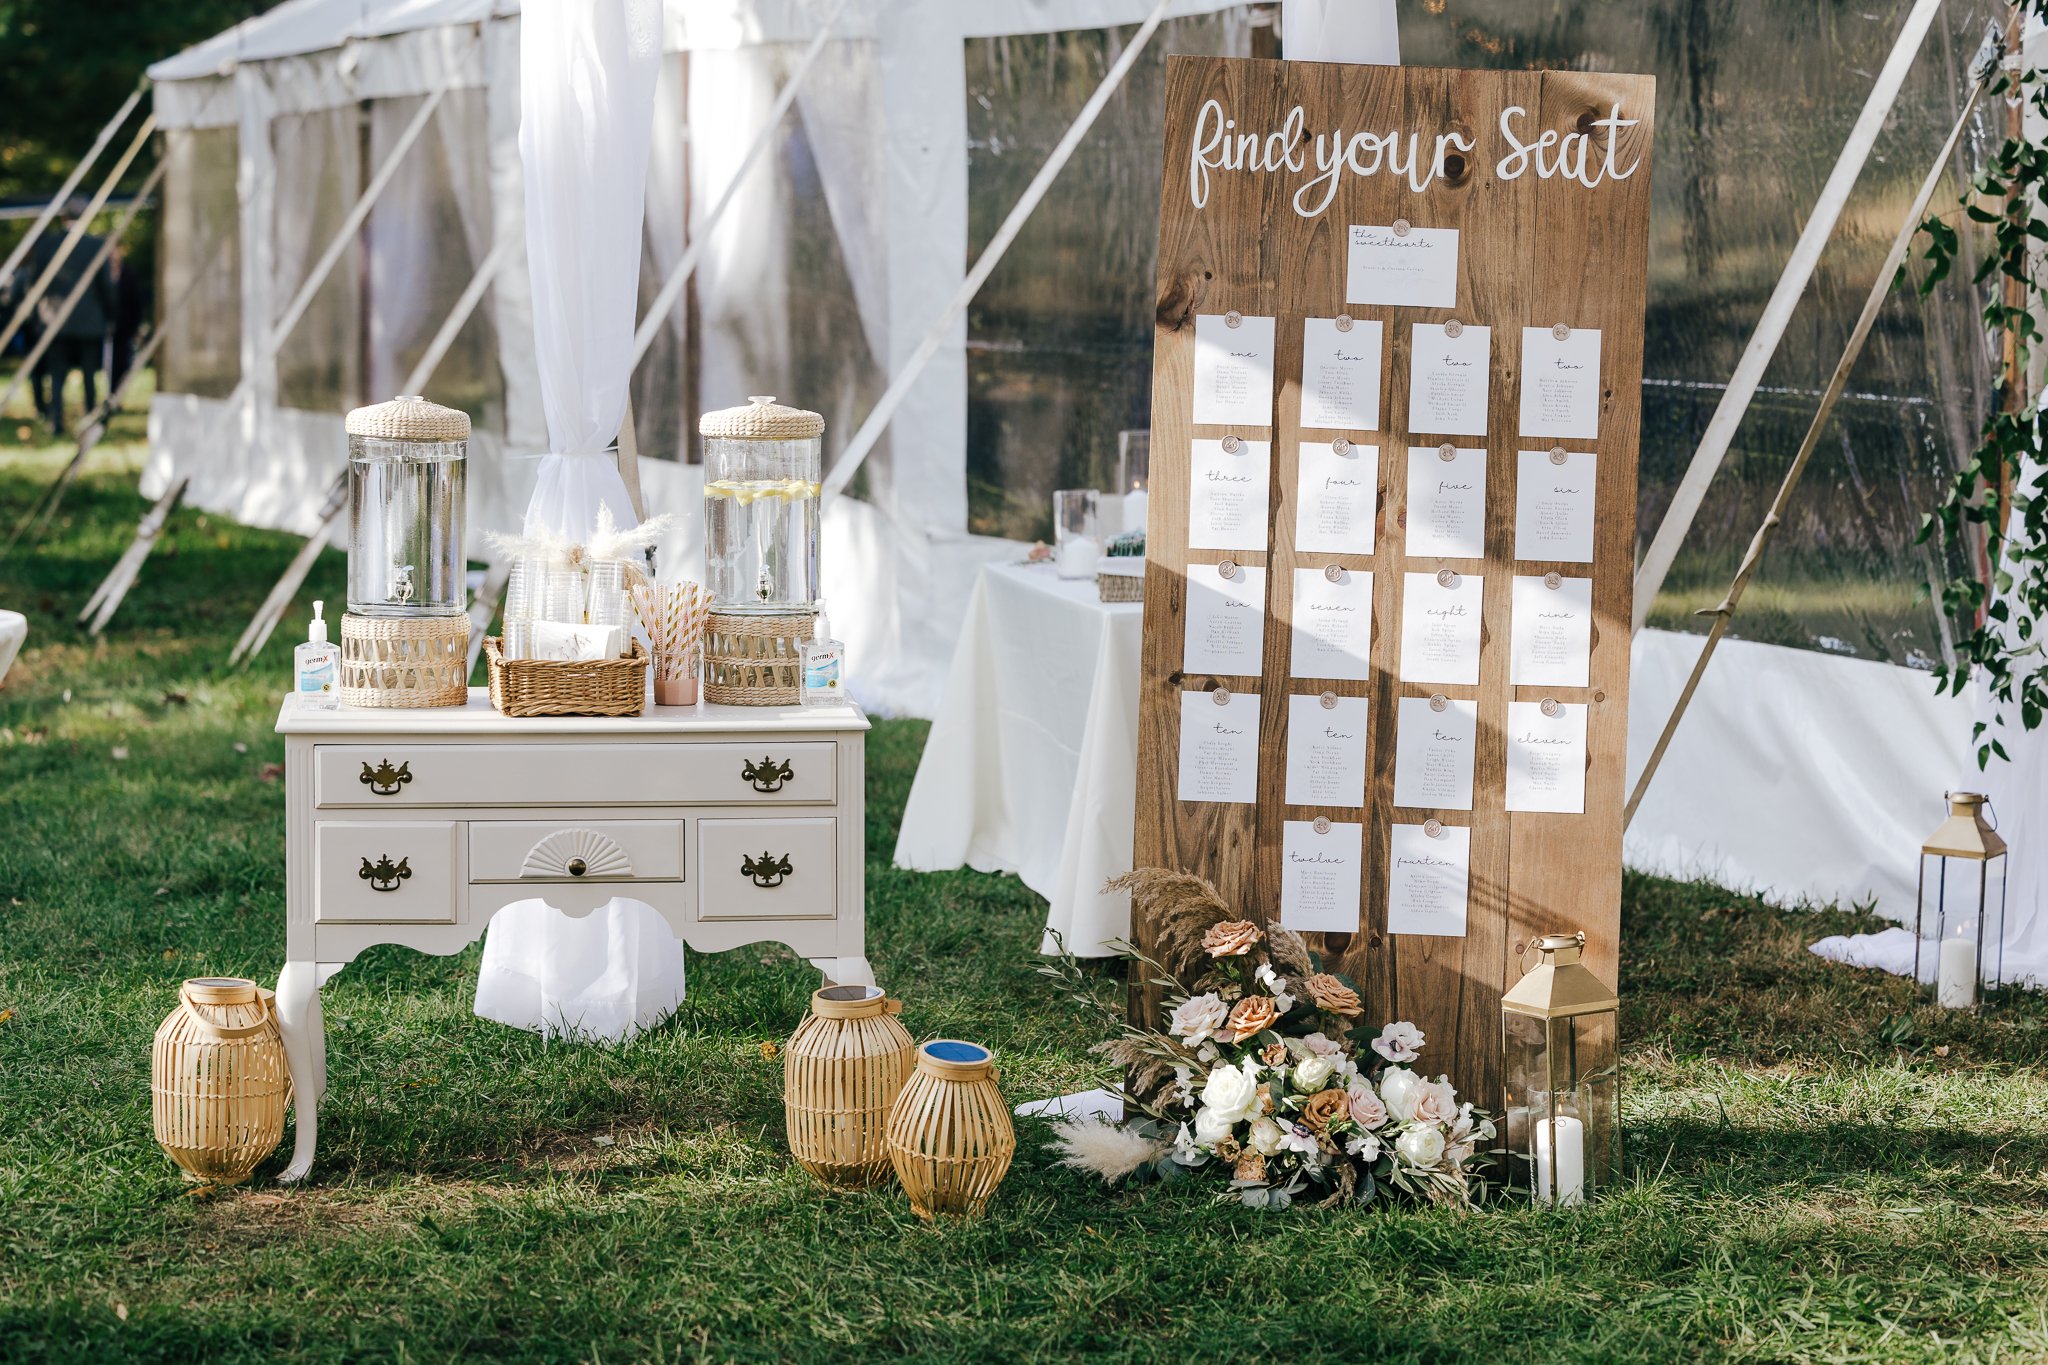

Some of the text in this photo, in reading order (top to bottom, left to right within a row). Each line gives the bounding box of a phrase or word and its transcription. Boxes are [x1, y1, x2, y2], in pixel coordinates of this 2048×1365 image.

[1190, 99, 1640, 218] find your Seat
[1353, 228, 1377, 239] the
[1355, 236, 1434, 248] sweethearts
[1230, 351, 1259, 359] one
[1333, 349, 1364, 361] two
[1442, 354, 1472, 367] two
[1554, 357, 1584, 370] two
[1205, 469, 1252, 483] three
[1325, 476, 1361, 490] four
[1438, 481, 1473, 494] five
[1553, 486, 1580, 494] six
[1225, 600, 1251, 608] six
[1310, 604, 1356, 612] seven
[1427, 605, 1468, 621] eight
[1538, 611, 1576, 619] nine
[1213, 722, 1243, 735] ten
[1323, 726, 1353, 739] ten
[1432, 729, 1462, 741] ten
[1517, 732, 1573, 745] eleven
[1289, 851, 1345, 864] twelve
[1397, 855, 1456, 868] fourteen
